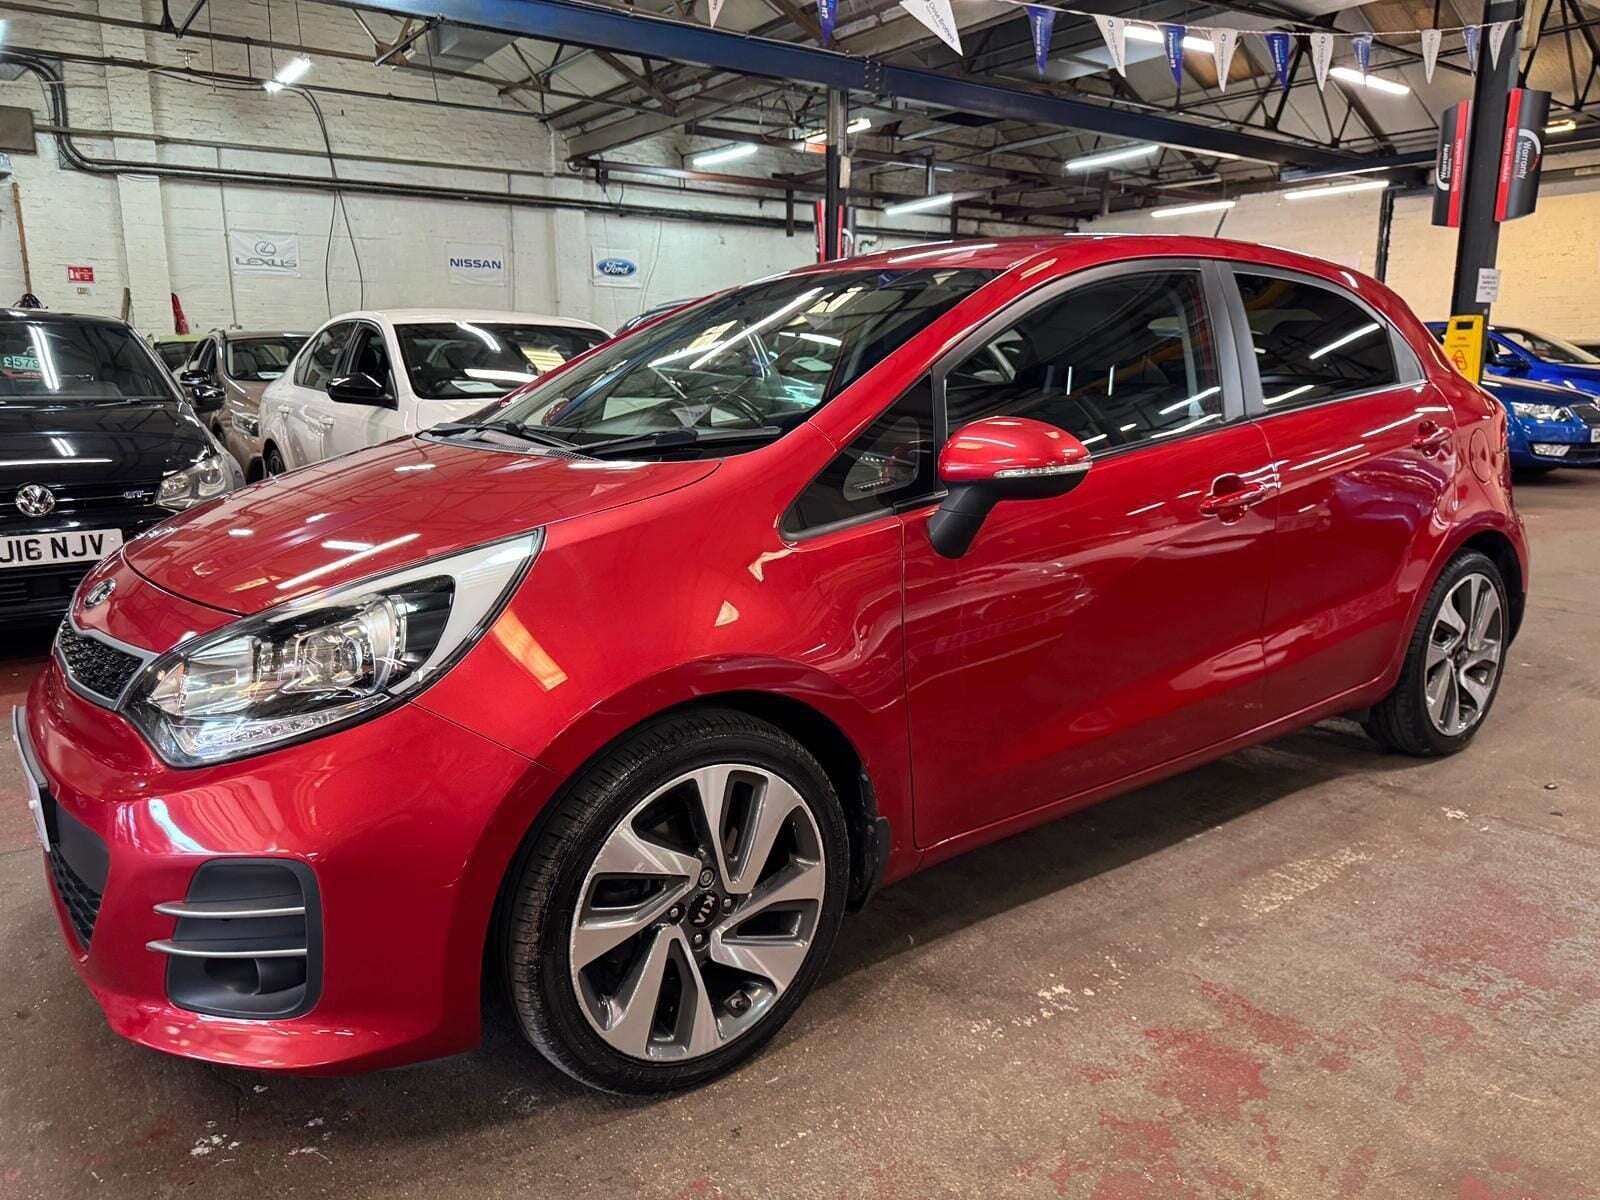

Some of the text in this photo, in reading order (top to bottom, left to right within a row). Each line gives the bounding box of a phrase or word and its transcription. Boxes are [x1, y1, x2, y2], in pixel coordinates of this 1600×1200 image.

[1440, 143, 1452, 180] Warranty
[1516, 140, 1533, 180] Warranty
[235, 256, 297, 268] LEXUS
[449, 257, 502, 270] NISSAN
[603, 260, 631, 274] Ford
[3, 355, 41, 369] £579
[50, 533, 104, 560] NJV
[693, 894, 716, 924] KIA
